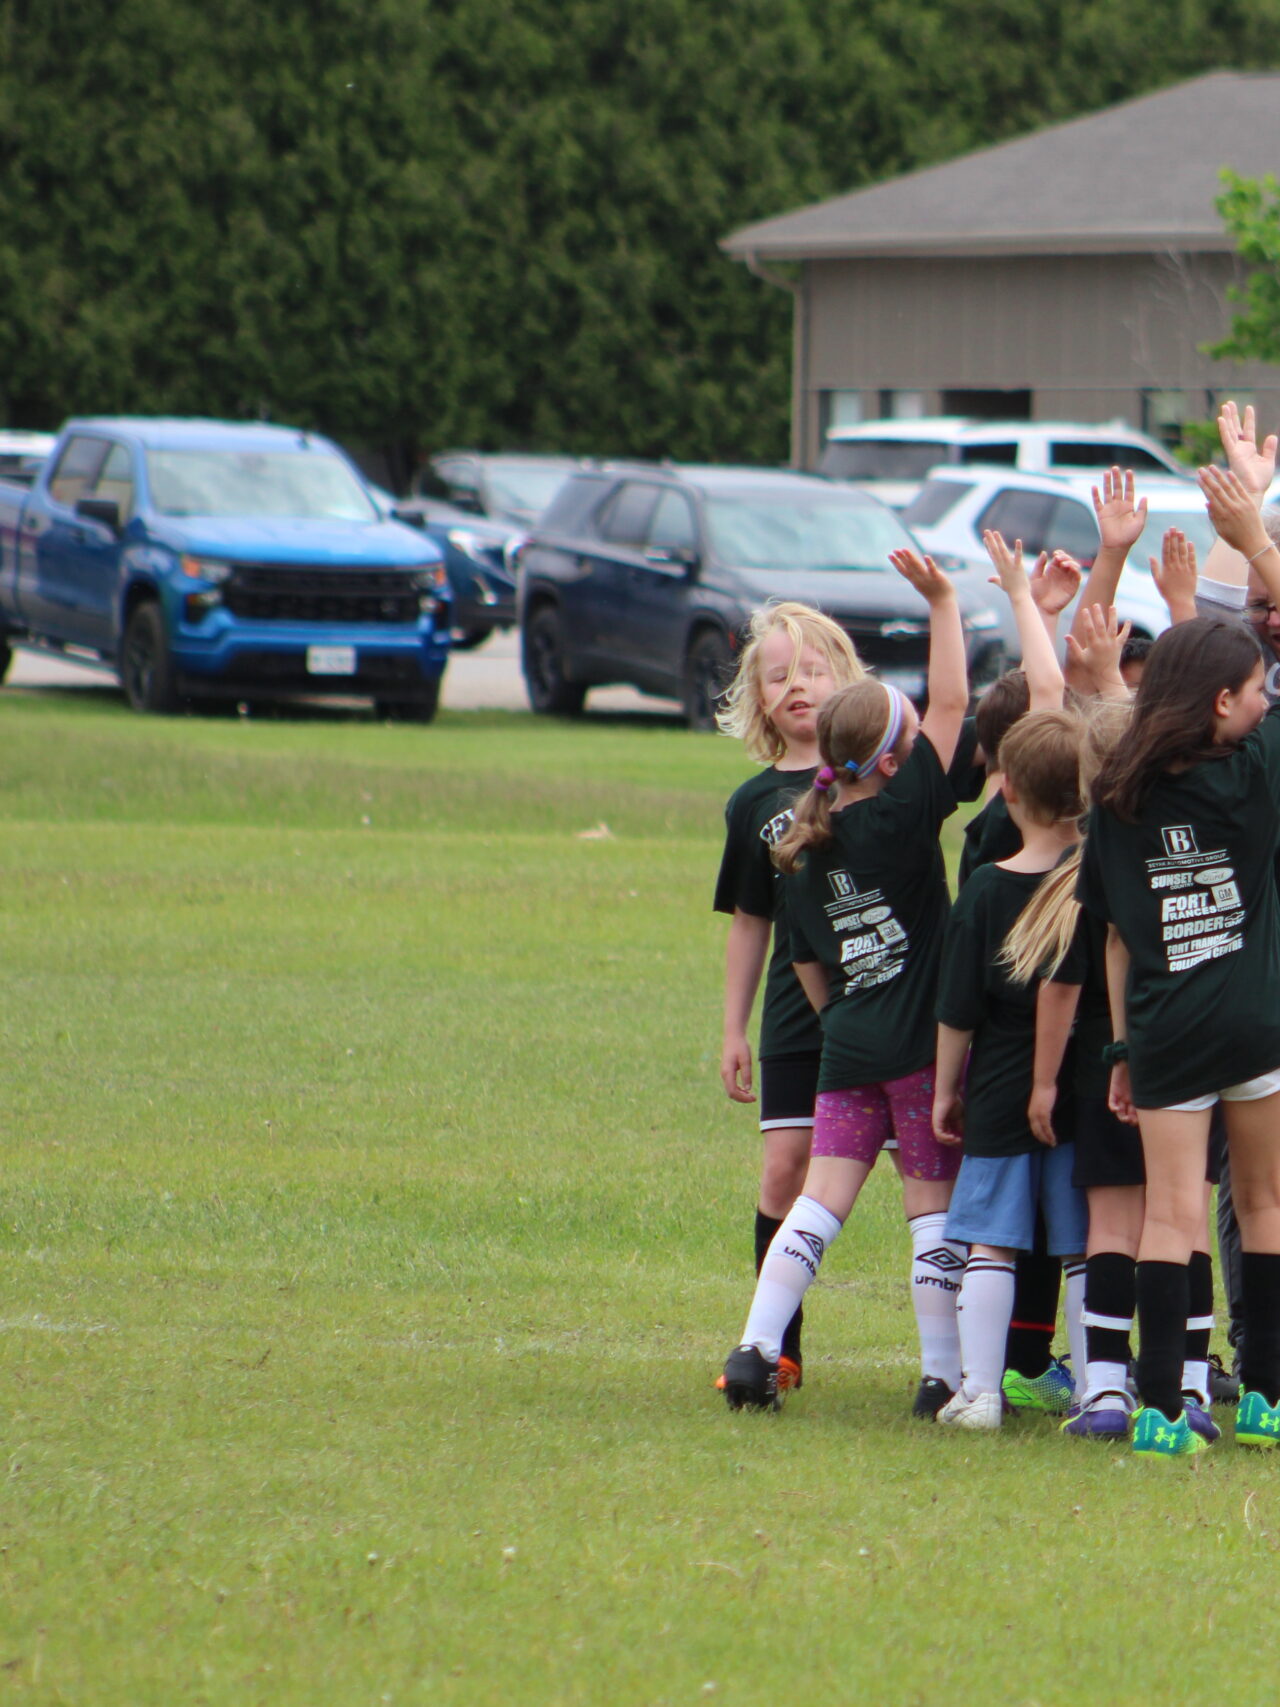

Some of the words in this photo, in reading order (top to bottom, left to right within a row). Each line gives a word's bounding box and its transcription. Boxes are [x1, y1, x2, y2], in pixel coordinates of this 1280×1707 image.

[1169, 830, 1191, 853] B
[1205, 853, 1226, 862] GROUP
[833, 873, 850, 896] B
[1151, 872, 1194, 889] SUNSET
[1170, 883, 1194, 891] COUNTRY
[1162, 892, 1208, 922] FORT
[1218, 887, 1233, 899] GM
[832, 913, 860, 932] SUNSET
[1163, 916, 1224, 941] BORDER
[840, 932, 878, 963] FORT
[1167, 941, 1190, 956] FORT
[1213, 938, 1244, 958] CENTRE
[843, 949, 890, 976] BORDER
[915, 1275, 963, 1292] umbr
